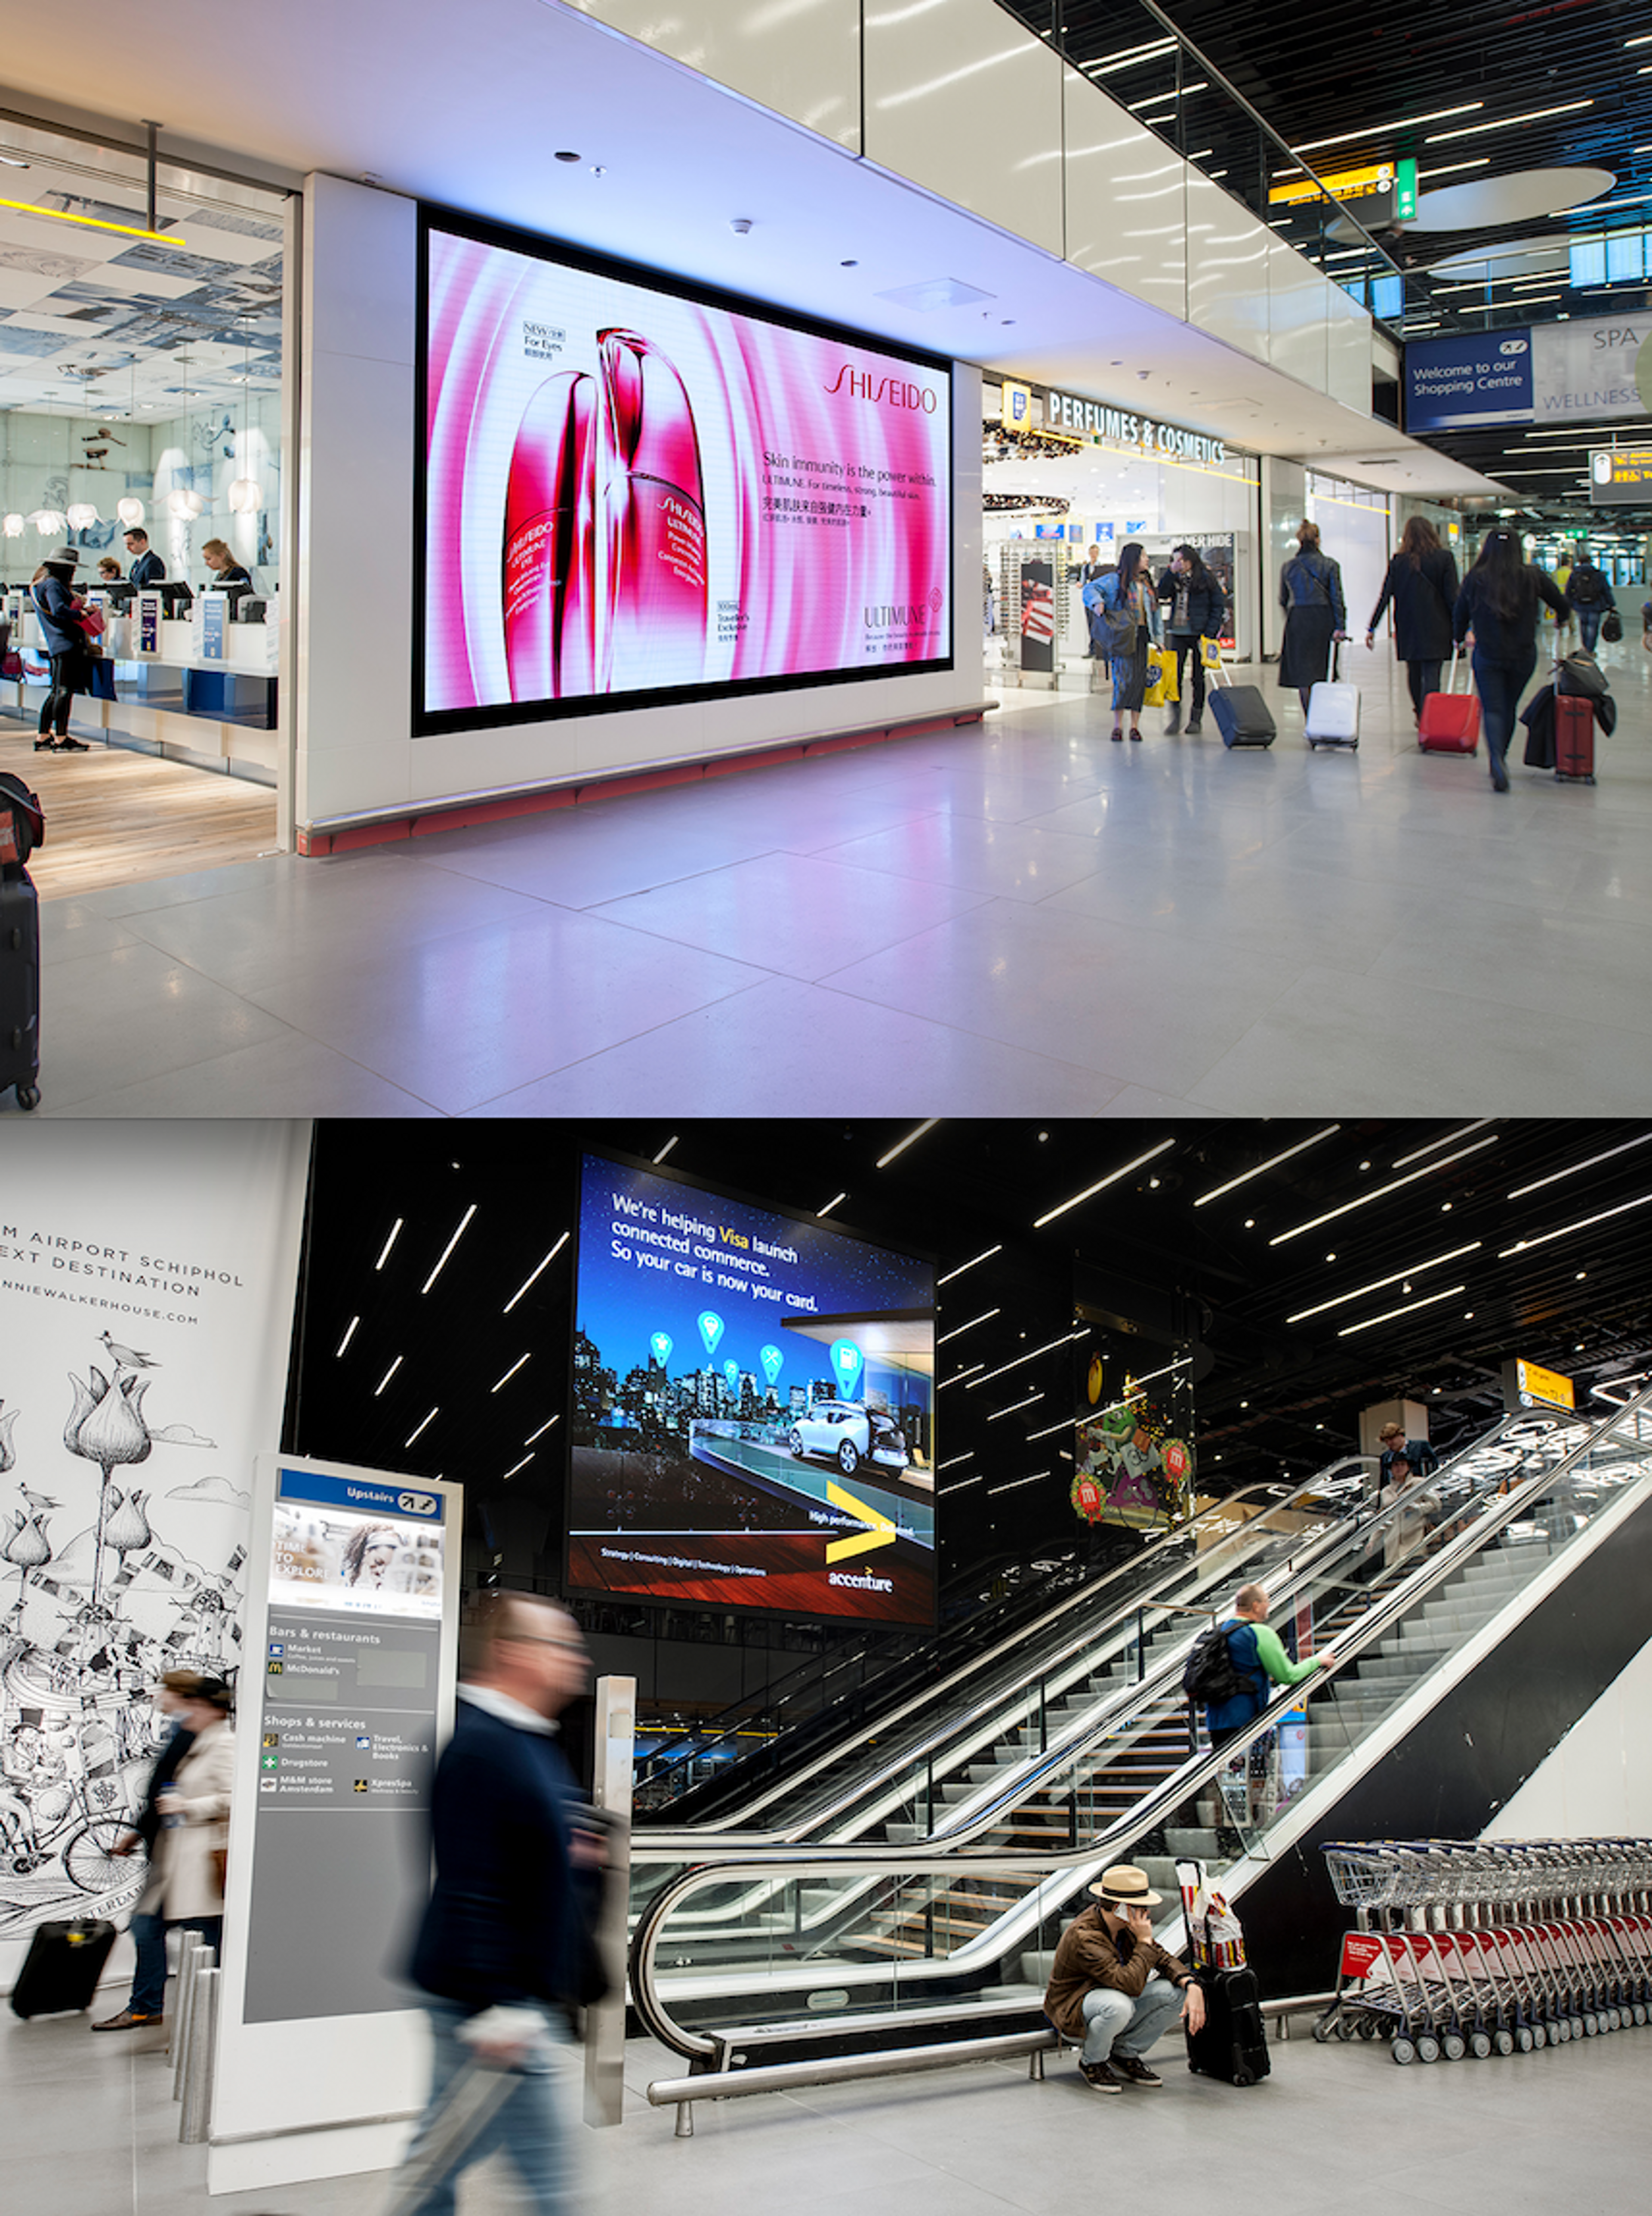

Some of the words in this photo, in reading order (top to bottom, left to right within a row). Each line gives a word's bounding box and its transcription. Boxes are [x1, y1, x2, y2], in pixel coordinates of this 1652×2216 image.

[524, 336, 539, 346] For
[542, 339, 563, 352] Eyes
[1593, 327, 1640, 350] SPA
[1413, 361, 1473, 381] Welcome
[1476, 360, 1490, 374] to
[1493, 358, 1517, 373] our
[823, 364, 937, 414] SHISEIDO
[1414, 378, 1474, 397] Shopping
[1476, 374, 1523, 389] Centre
[1543, 388, 1642, 410] WELLNESS
[1049, 392, 1138, 444] PERFUMES
[1142, 420, 1153, 447] &
[1157, 424, 1225, 466] COSMETICS
[763, 451, 789, 469] Skin
[792, 456, 844, 479] immunity
[847, 463, 856, 477] is
[858, 465, 875, 480] the
[878, 469, 906, 484] power
[908, 472, 937, 487] within.
[762, 474, 806, 489] ULTIMUNE.
[808, 479, 820, 490] For
[822, 482, 852, 494] timeless,
[854, 485, 877, 498] strong,
[878, 487, 906, 499] beautiful
[656, 497, 704, 537] SHISEIDO
[506, 521, 553, 563] SHISEIDO
[1208, 534, 1232, 547] HIDE
[864, 604, 925, 628] ULTIMUNE
[612, 1193, 657, 1222] We're
[661, 1209, 716, 1243] helping
[719, 1225, 749, 1250] Visa
[752, 1235, 799, 1264] launch
[29, 1232, 129, 1262] AIRPORT
[140, 1255, 244, 1287] SCHIPHOL
[611, 1220, 690, 1255] connected
[693, 1244, 770, 1278] commerce.
[52, 1256, 200, 1297] DESTINATION
[611, 1239, 632, 1261] So
[635, 1250, 670, 1269] your
[674, 1261, 698, 1279] car
[701, 1265, 714, 1284] is
[717, 1274, 749, 1293] now
[750, 1282, 783, 1300] your
[785, 1291, 820, 1312] card.
[2, 1279, 198, 1325] NNIEWALKERHOUSE.COM
[347, 1486, 395, 1503] Upstairs
[808, 1510, 829, 1525] High
[275, 1552, 294, 1564] TO
[634, 1552, 668, 1566] Consulting
[735, 1565, 767, 1577] Operations
[274, 1565, 330, 1579] EXPLORE
[829, 1571, 893, 1593] accenture
[269, 1626, 296, 1638] Bars
[299, 1628, 309, 1639] &
[312, 1630, 381, 1645] restaurants
[287, 1644, 321, 1654] Market
[287, 1664, 340, 1675] McDonald's
[264, 1715, 302, 1728] Shops
[306, 1717, 315, 1727] &
[318, 1719, 366, 1730] services
[282, 1733, 306, 1742] Cash
[306, 1735, 346, 1744] machine
[373, 1735, 402, 1744] Travel,
[373, 1743, 420, 1752] Electronics
[421, 1744, 429, 1753] &
[281, 1758, 328, 1769] Drugstore
[279, 1785, 334, 1794] Amsterdam
[280, 1775, 306, 1784] M&M
